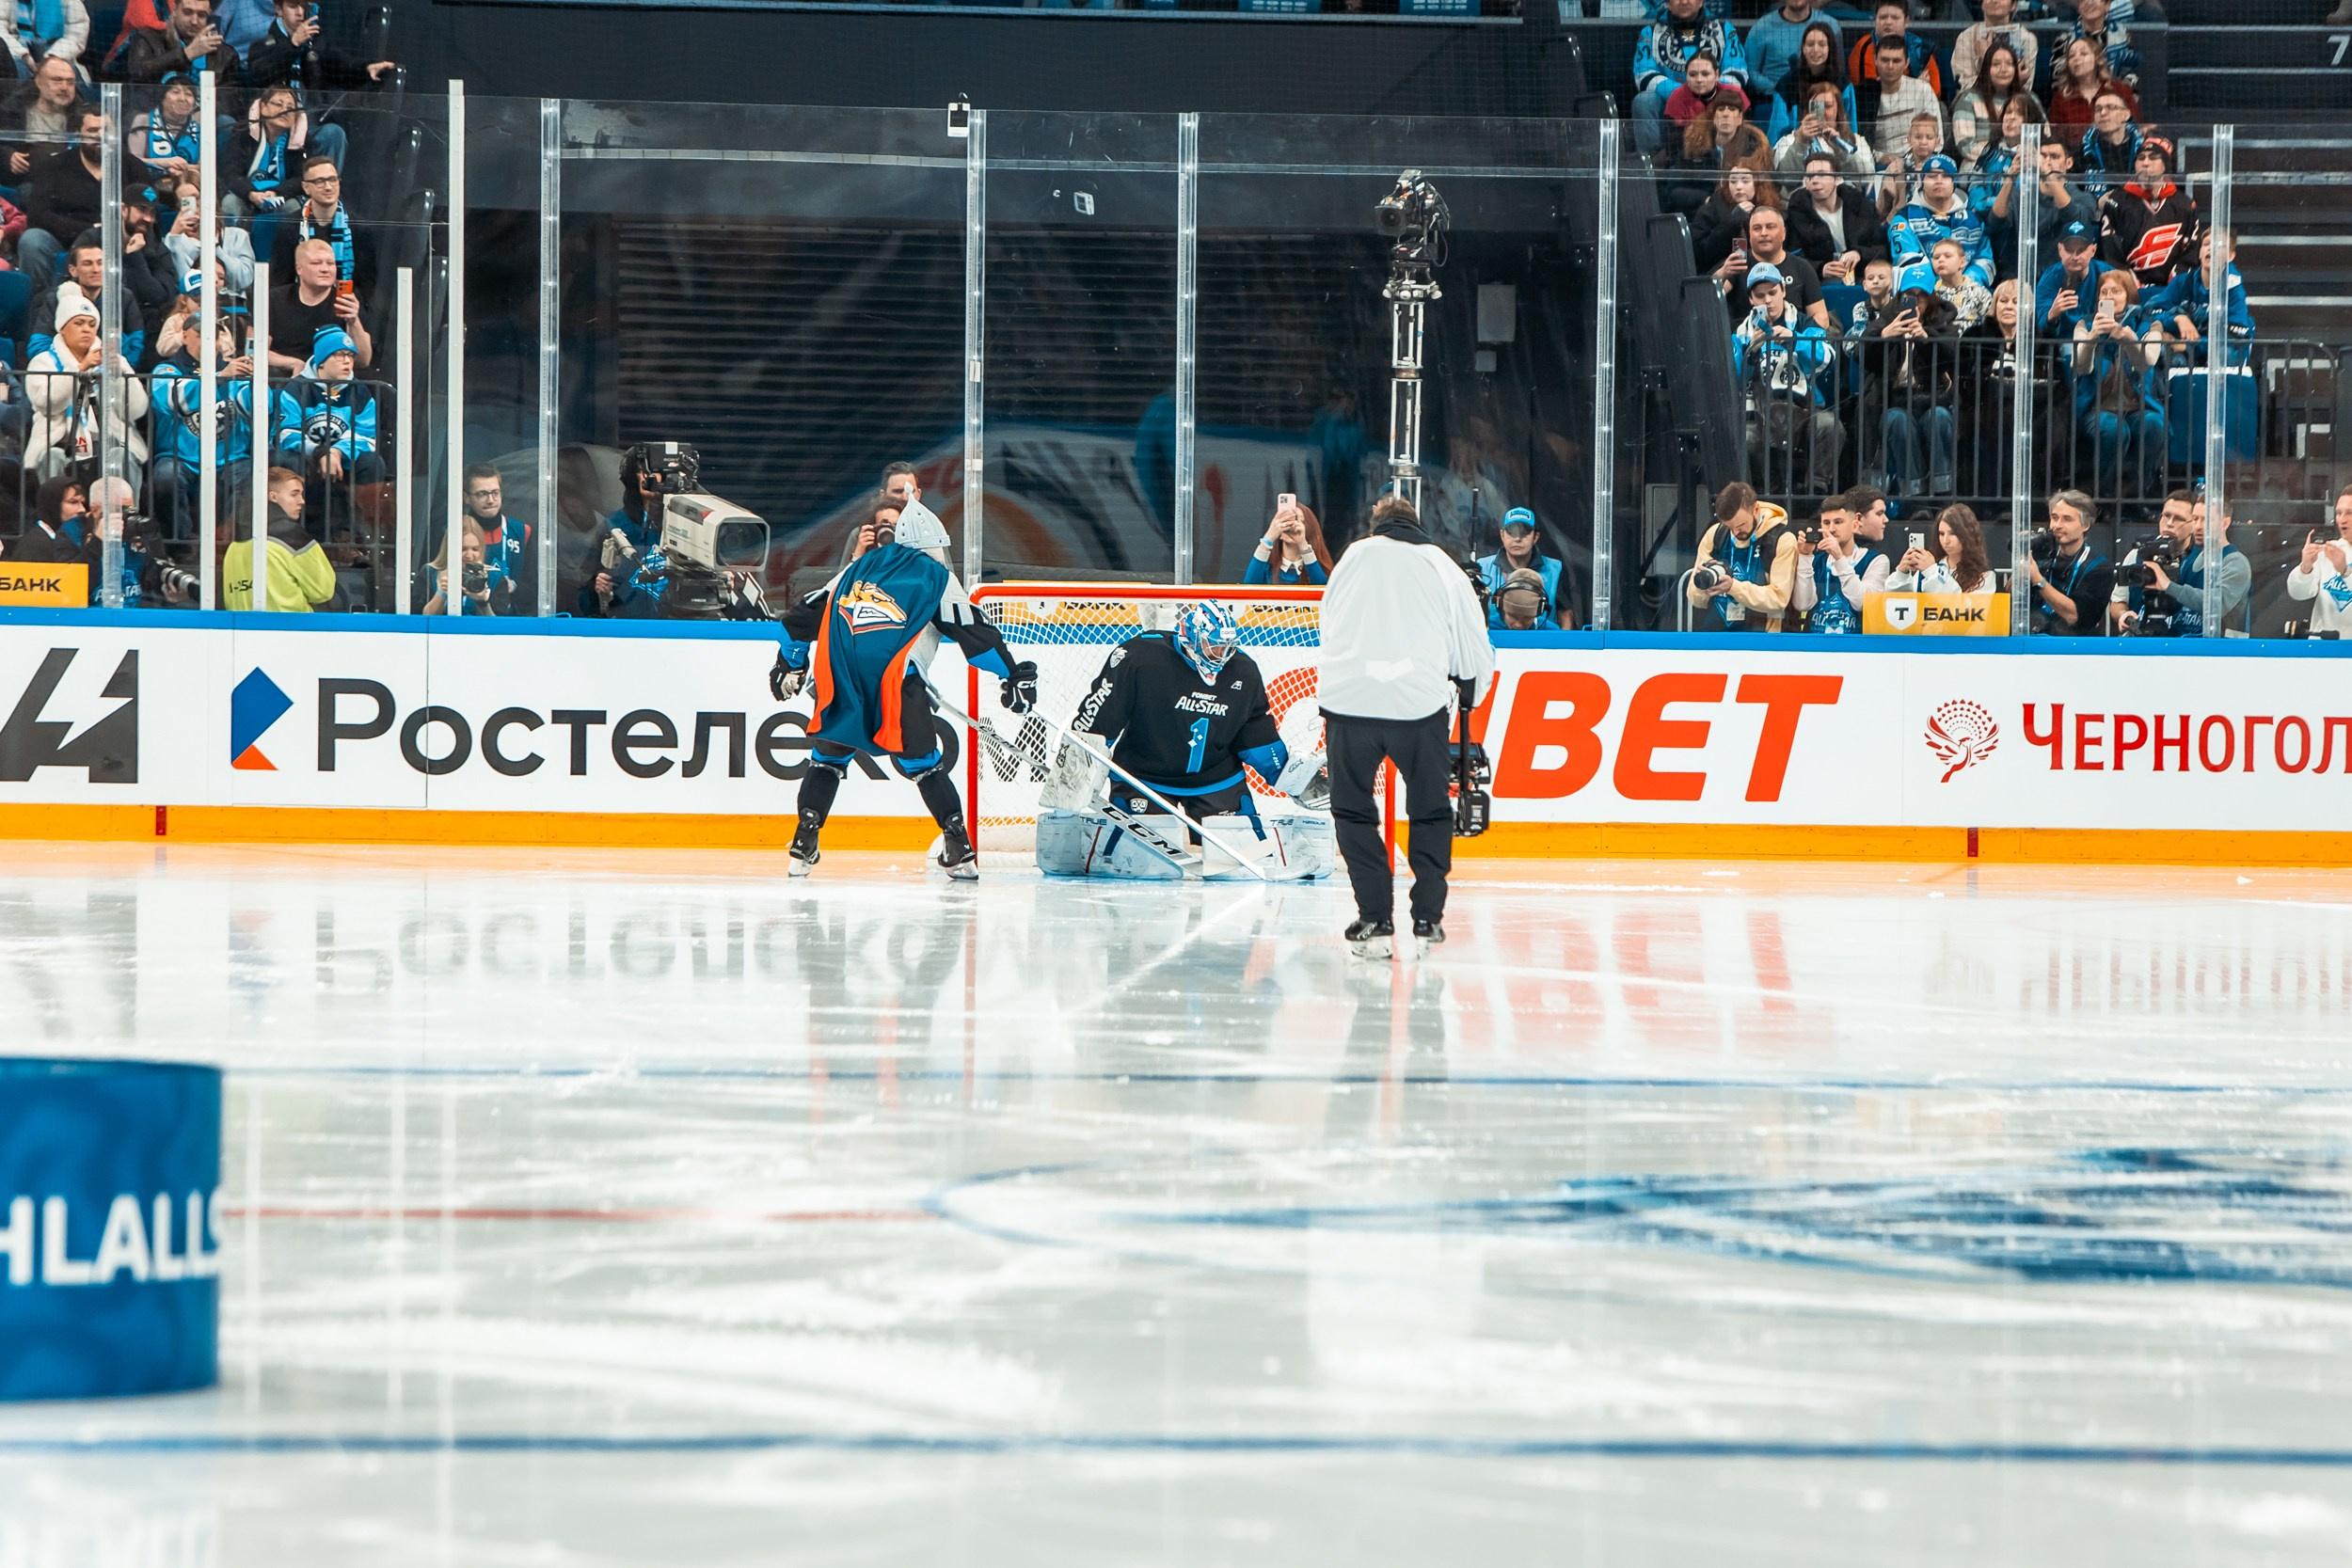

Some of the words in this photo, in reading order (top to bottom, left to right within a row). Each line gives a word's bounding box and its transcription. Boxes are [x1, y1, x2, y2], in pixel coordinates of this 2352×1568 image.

[2327, 35, 2351, 65] 7
[507, 539, 520, 553] 95
[1923, 607, 1986, 621] БАНК
[1191, 691, 1217, 702] FONBET
[318, 678, 1049, 783] Ростелеом
[1186, 717, 1210, 773] 1
[1080, 816, 1107, 826] TRUE
[1269, 818, 1295, 827] TRUE
[1102, 805, 1183, 856] CCM
